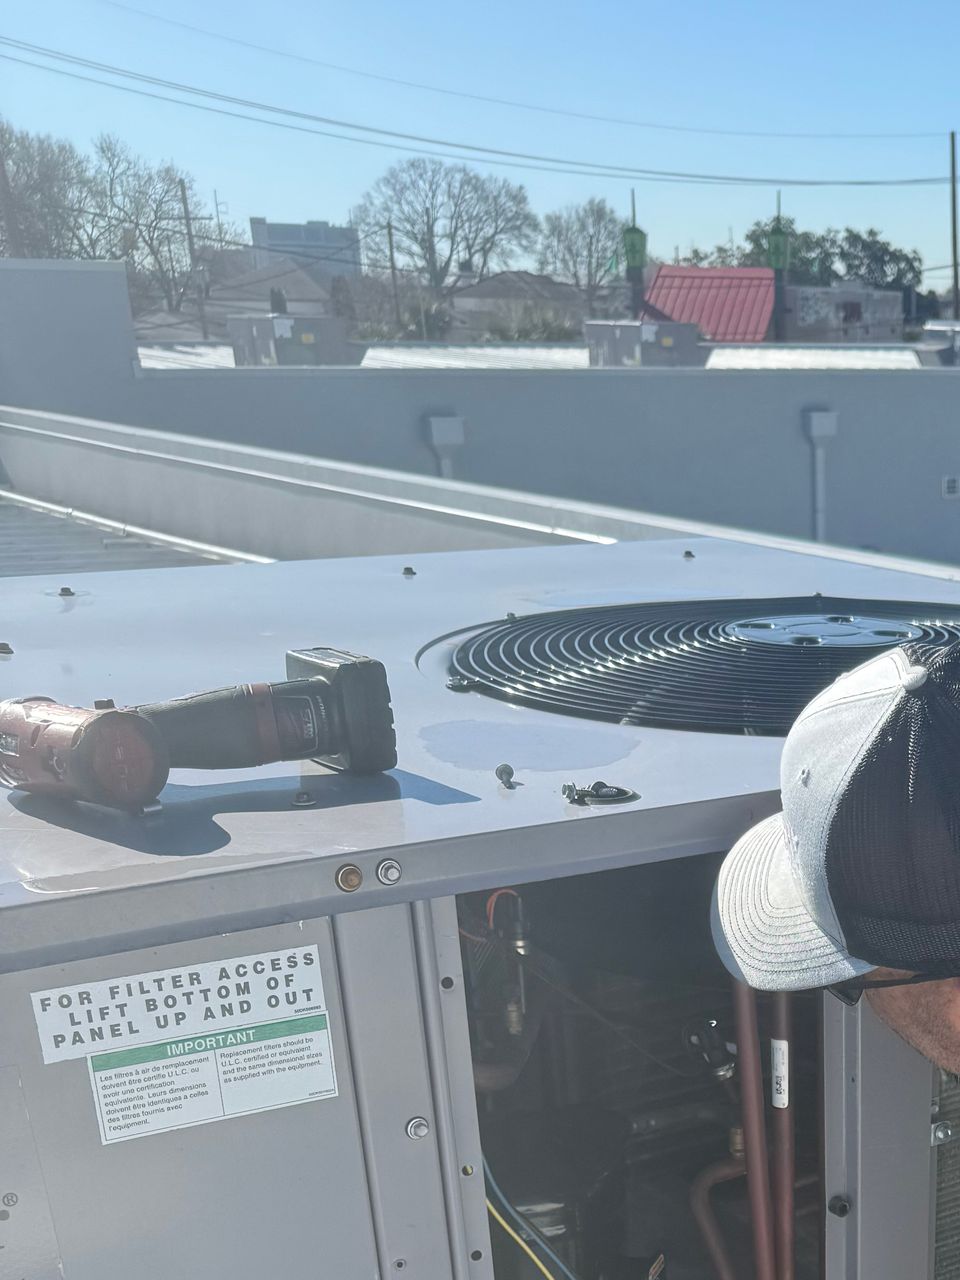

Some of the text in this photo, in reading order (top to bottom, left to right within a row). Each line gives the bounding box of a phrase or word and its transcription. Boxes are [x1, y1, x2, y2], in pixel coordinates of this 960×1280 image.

[40, 953, 314, 1012] FOR FILTER ACCESS
[69, 974, 294, 1026] LIFT BOTTOM OF
[53, 988, 313, 1048] PANEL UP AND OUT
[167, 1030, 255, 1056] IMPORTANT
[220, 1046, 263, 1059] Replacement
[263, 1043, 282, 1051] filters
[283, 1038, 304, 1048] should
[243, 1052, 270, 1063] certified
[278, 1045, 311, 1057] equivalent
[114, 1071, 134, 1080] filtres
[151, 1065, 160, 1073] de
[162, 1056, 209, 1070] remplacement
[222, 1068, 235, 1076] and
[248, 1063, 266, 1071] same
[267, 1054, 306, 1067] dimensional
[306, 1052, 323, 1060] sizes
[233, 1071, 261, 1082] supplied
[261, 1067, 275, 1076] with
[101, 1080, 127, 1090] doivent
[103, 1080, 175, 1099] avoir une certification
[147, 1089, 167, 1098] Leurs
[168, 1082, 207, 1094] dimensions
[106, 1105, 131, 1115] doivent
[147, 1095, 182, 1109] identiques
[189, 1090, 209, 1098] celles
[107, 1104, 183, 1124] des filtres fournis avec
